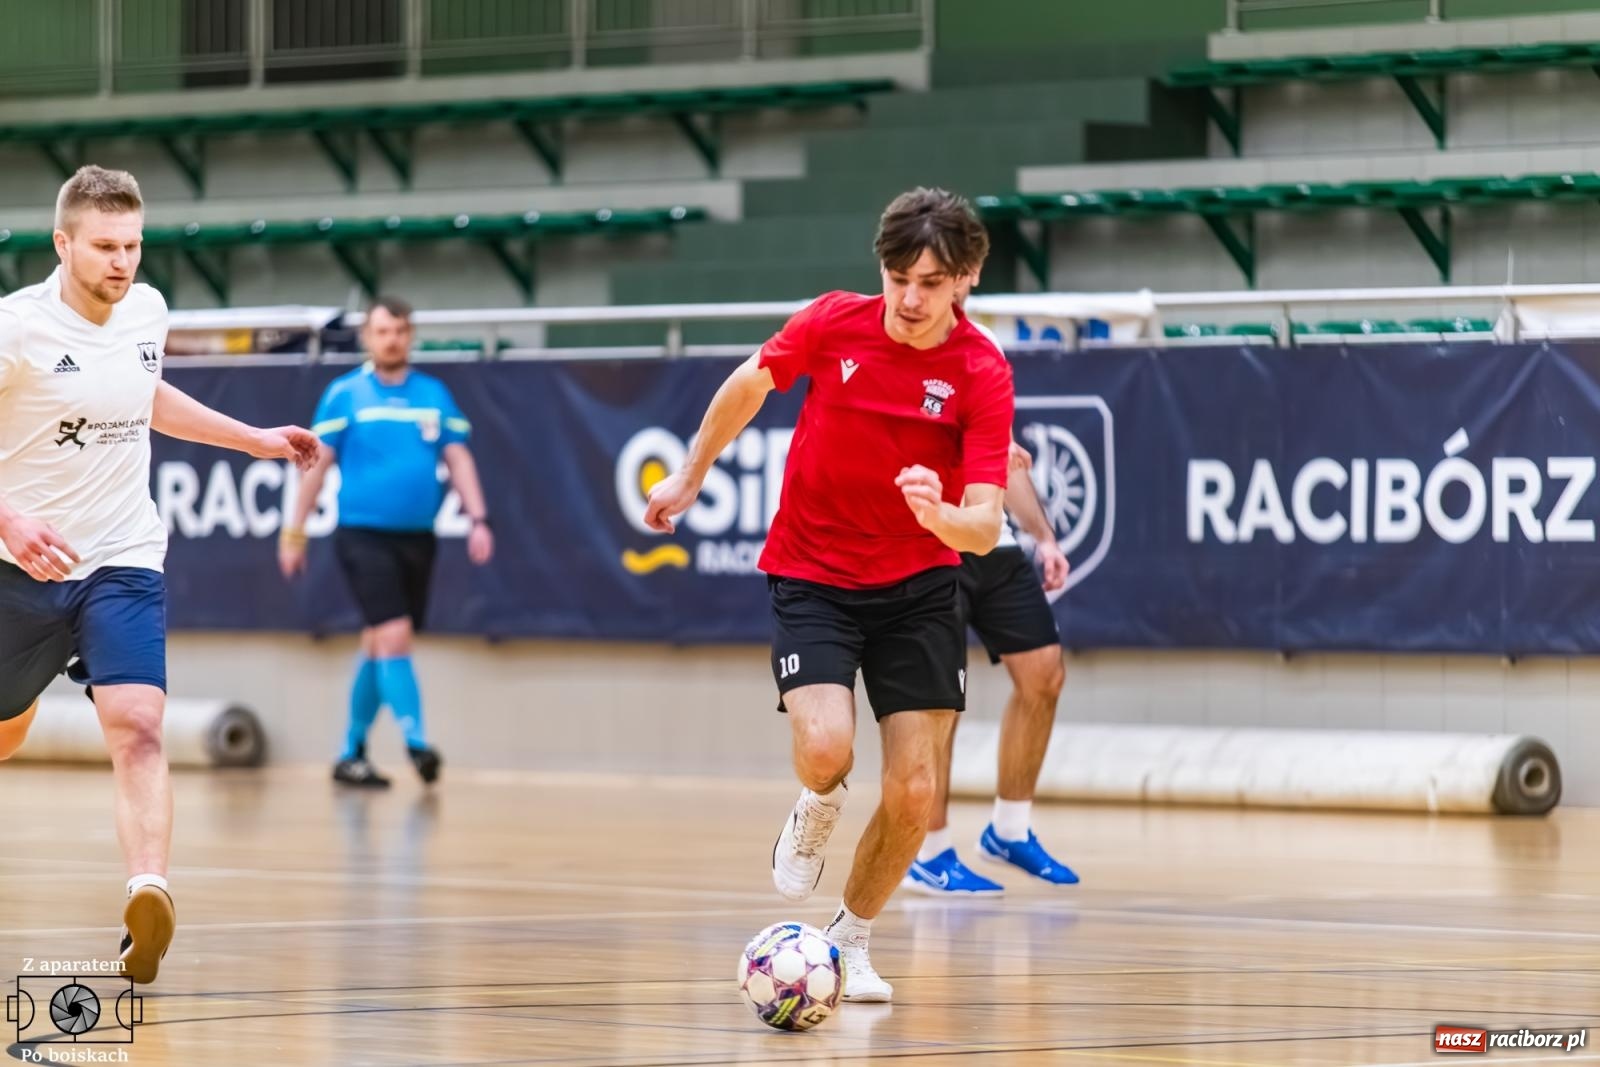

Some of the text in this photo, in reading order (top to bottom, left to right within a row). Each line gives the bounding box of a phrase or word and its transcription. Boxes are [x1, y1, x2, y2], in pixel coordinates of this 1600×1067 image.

[53, 366, 81, 374] adidas
[923, 398, 942, 413] KS
[1186, 427, 1596, 544] RACIBÓRZ
[779, 653, 801, 678] 10
